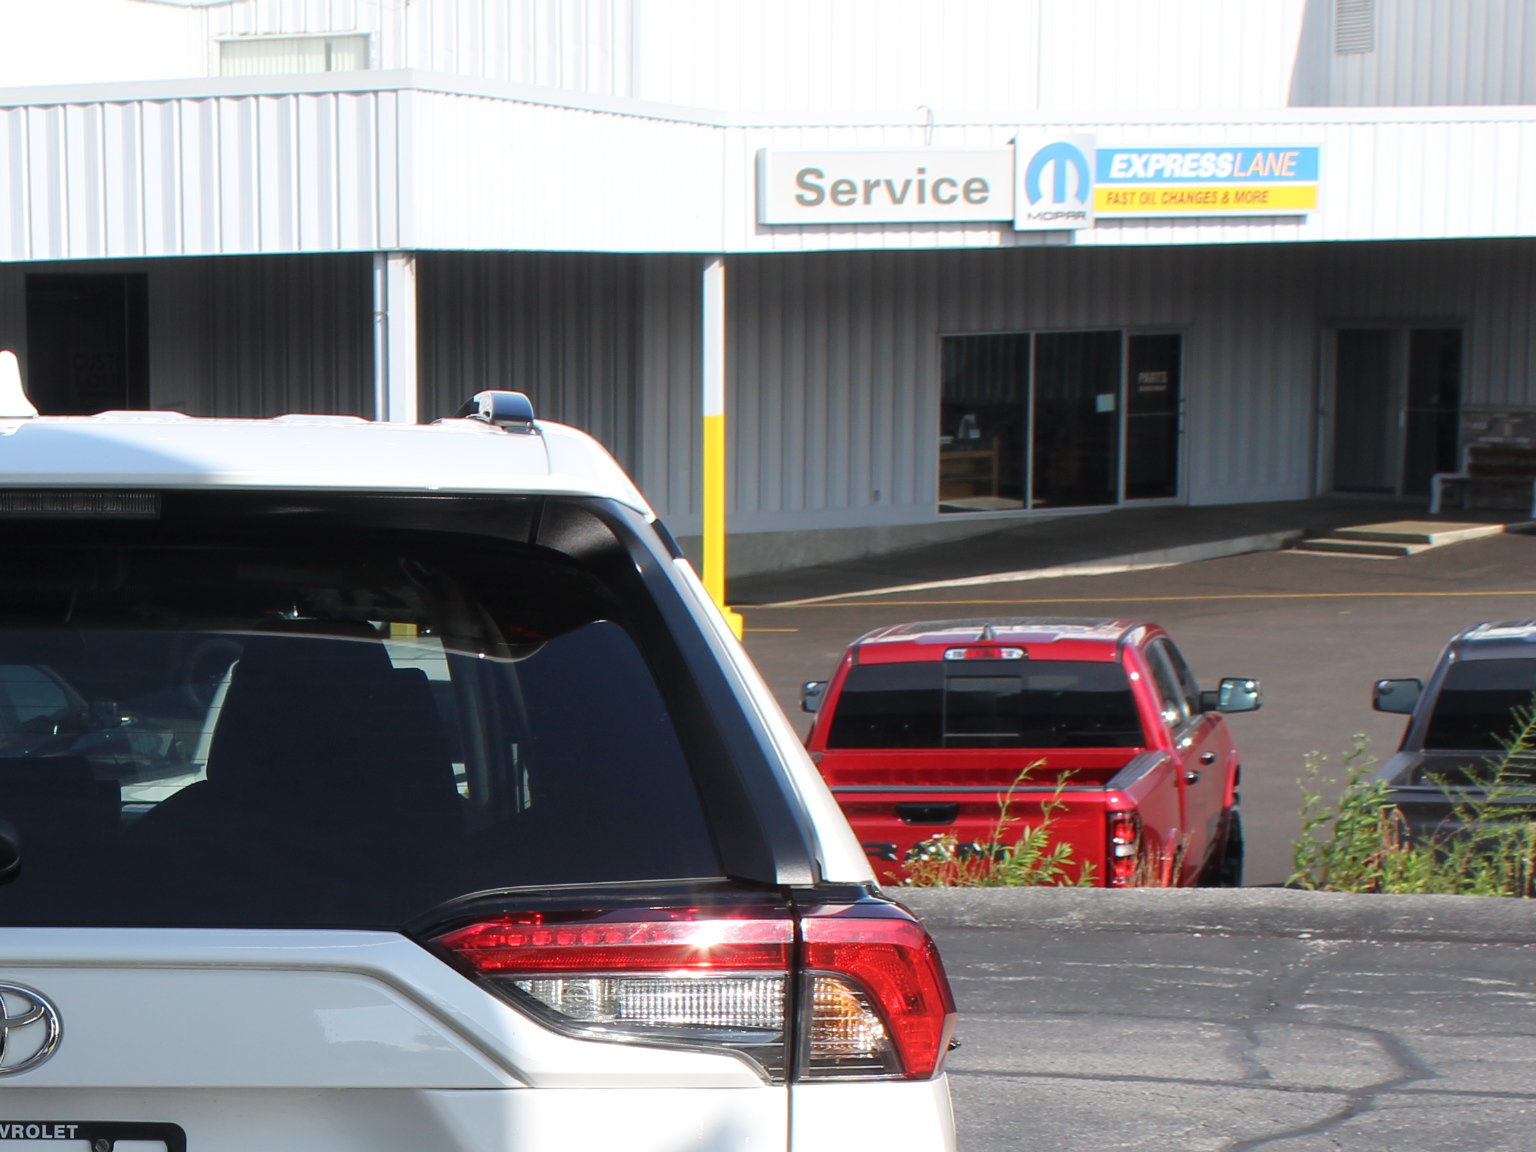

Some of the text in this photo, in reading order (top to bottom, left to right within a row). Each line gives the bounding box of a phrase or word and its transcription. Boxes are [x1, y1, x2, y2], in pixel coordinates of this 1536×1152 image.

[1109, 151, 1300, 178] EXPRESSLANE
[795, 167, 990, 206] Service
[1106, 190, 1270, 205] FAST OIL CHANGES & MORE
[1027, 211, 1087, 221] MOPAR
